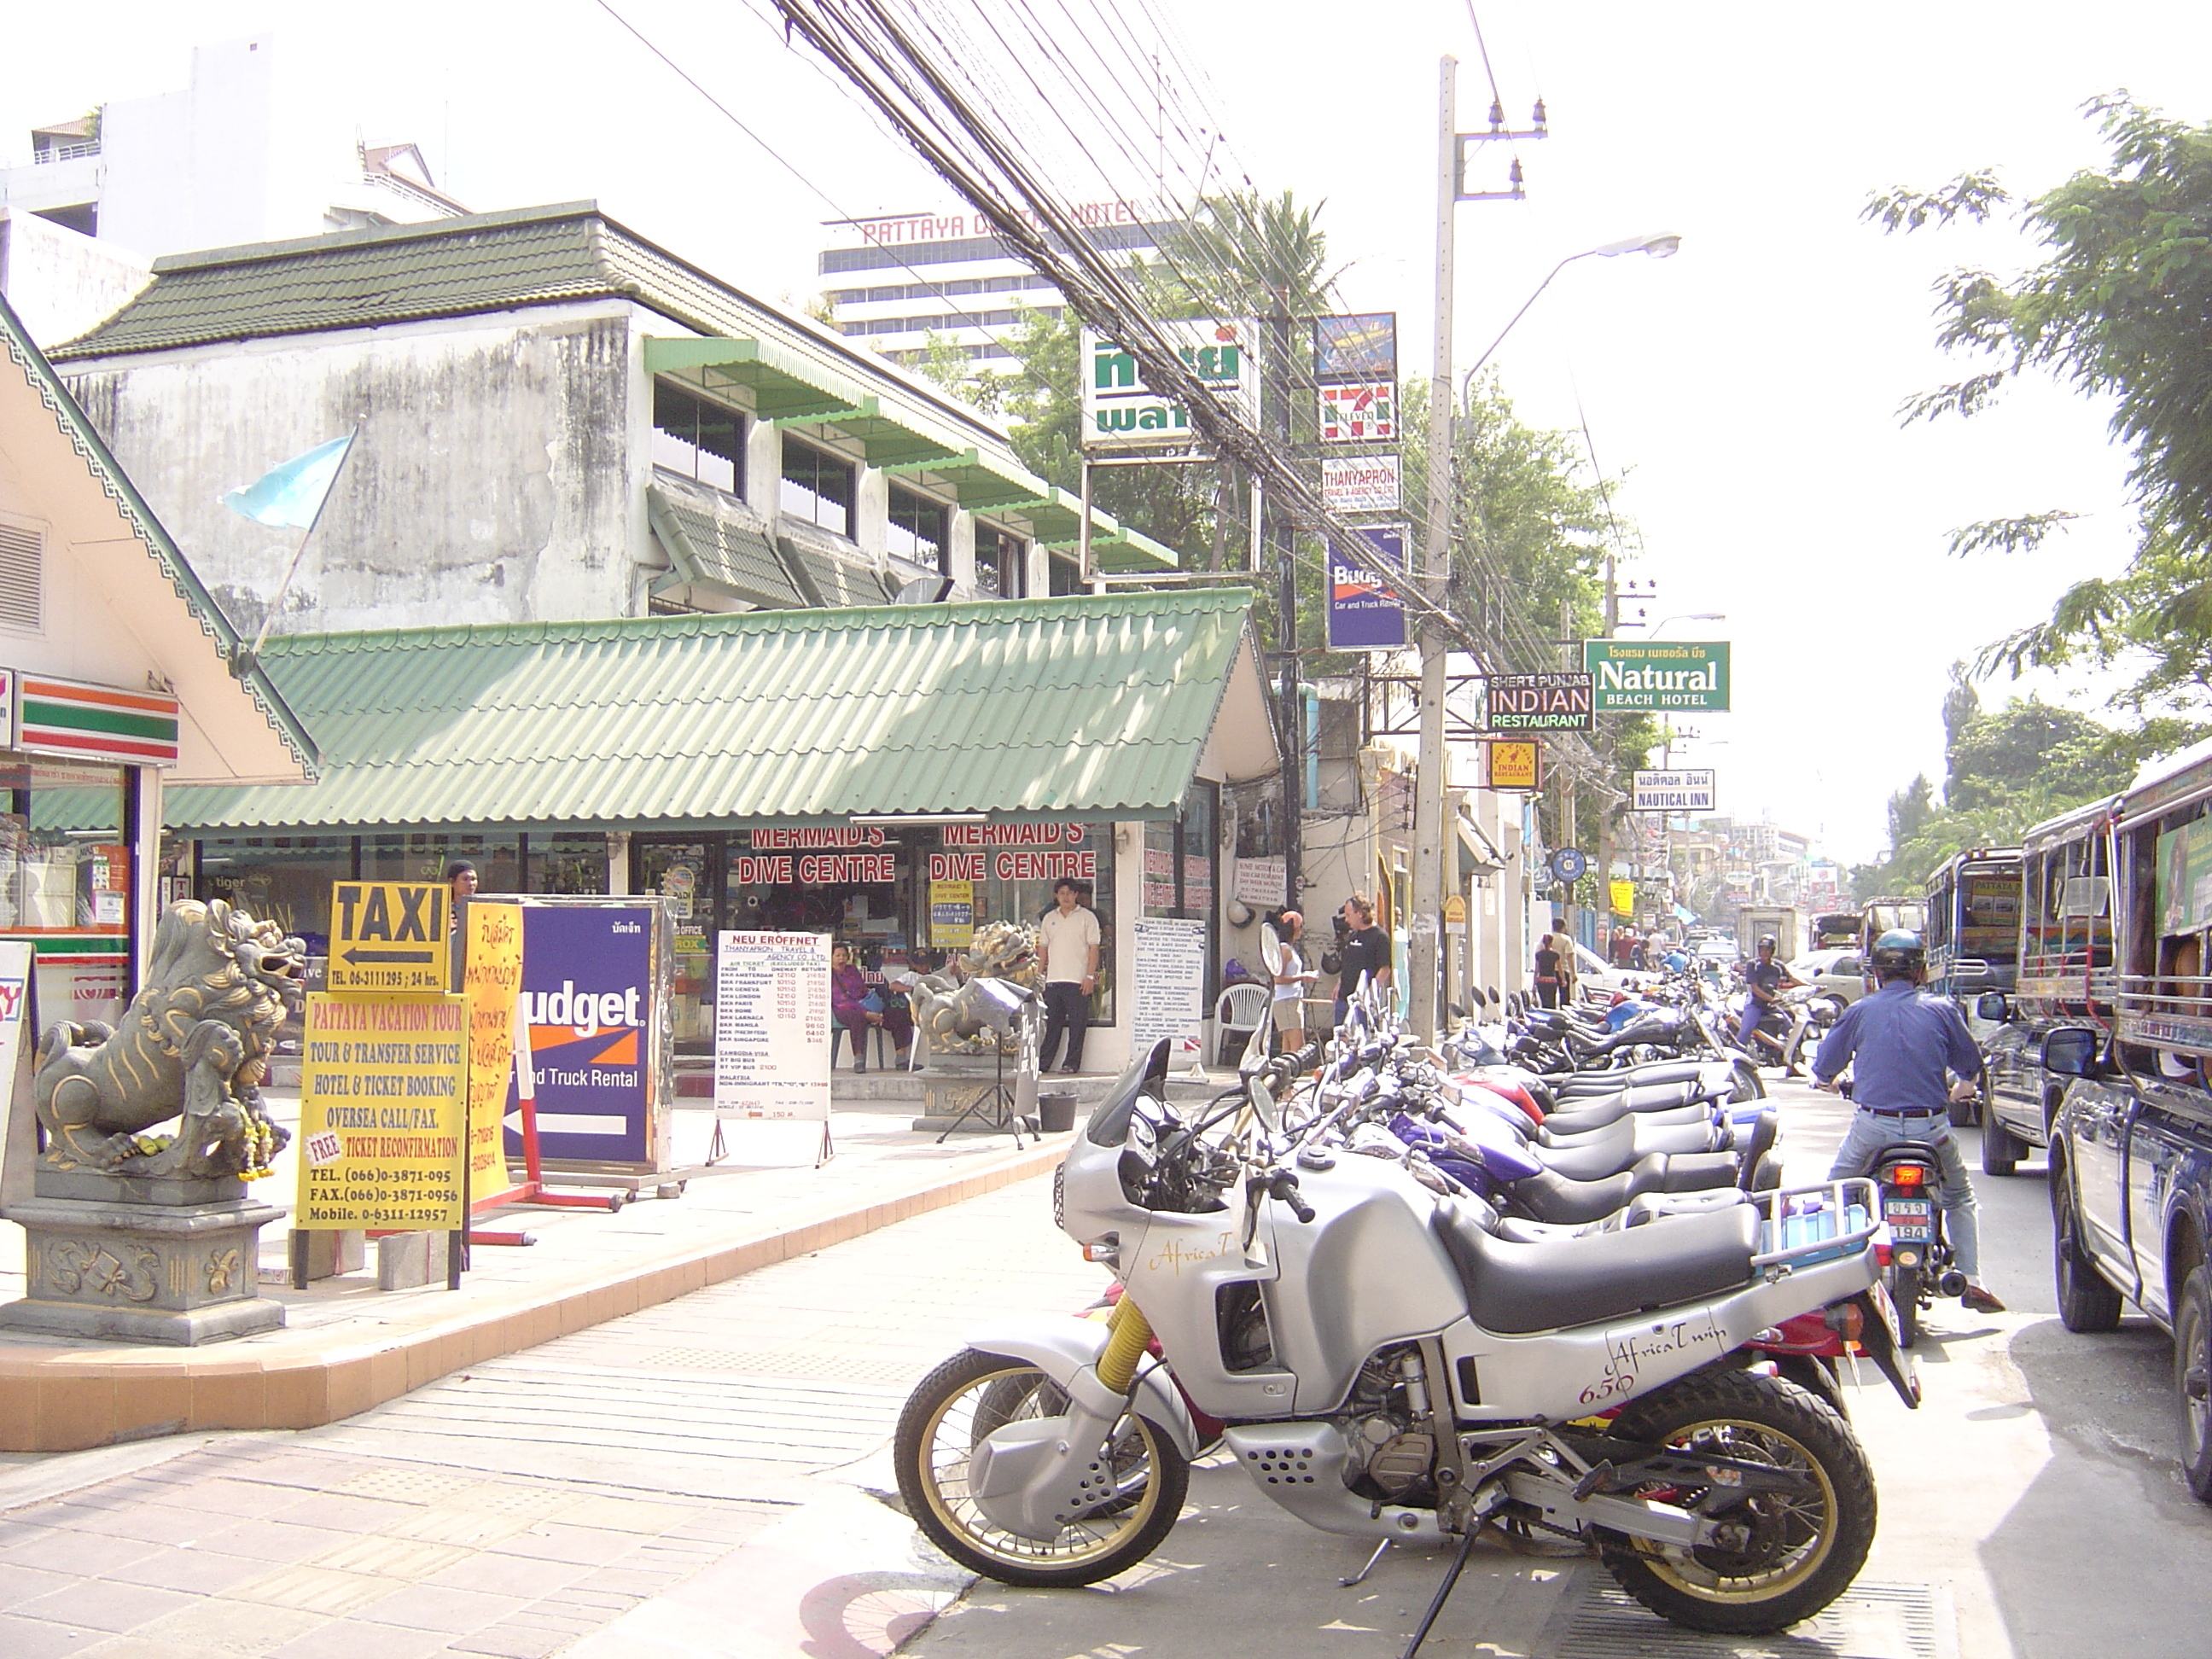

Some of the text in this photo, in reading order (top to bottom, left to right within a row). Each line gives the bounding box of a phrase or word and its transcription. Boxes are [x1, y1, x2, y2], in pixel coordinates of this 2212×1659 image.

[864, 216, 963, 244] PATTAYA
[1324, 469, 1394, 486] THANYAPRON
[1335, 602, 1346, 610] Car
[1347, 601, 1359, 609] and
[1361, 600, 1378, 608] Truck
[1540, 674, 1591, 687] PUNJAB
[1598, 661, 1717, 691] Natural
[1491, 688, 1590, 713] INDIAN
[1606, 694, 1708, 705] BEACH HOTEL
[1492, 714, 1587, 728] RESTAURANT
[1639, 792, 1708, 806] NAUTICAL INN
[752, 826, 885, 849] MERMAID'S
[943, 822, 1086, 846] MERMAID'S
[739, 854, 896, 884] DIVE CENTRE
[930, 851, 1097, 882] DIVE CENTRE
[216, 876, 245, 889] tiger
[1976, 882, 2012, 890] PATTAYA
[337, 886, 443, 942] TAXI
[681, 926, 702, 935] OFFICE
[733, 935, 756, 943] NEU
[302, 967, 322, 979] ive
[332, 971, 346, 985] TEL.
[349, 970, 402, 987] 06-3111295
[411, 972, 422, 986] 24
[425, 971, 439, 987] hrs.
[313, 1003, 367, 1030] PATTAYA
[371, 1004, 431, 1031] VACATION
[432, 1004, 462, 1032] TOUR
[523, 980, 640, 1037] udget
[310, 1042, 339, 1062] TOUR
[343, 1042, 351, 1063] &
[354, 1043, 411, 1064] TRANSFER
[414, 1044, 461, 1064] SERVICE
[314, 1074, 349, 1095] HOTEL
[352, 1075, 361, 1096] &
[364, 1075, 404, 1096] TICKET
[407, 1076, 456, 1097] BOOKING
[549, 1068, 588, 1086] Truck
[591, 1069, 638, 1087] Rental
[326, 1107, 439, 1132] OVERSEA CALL/FAX.
[310, 1134, 341, 1162] FREE
[346, 1137, 458, 1158] TICKET RECONFIRMATION
[311, 1167, 451, 1183] TEL. (066)0-3871-095
[310, 1208, 448, 1222] Mobile. 0-6311-12957
[1896, 1227, 1923, 1238] 194
[1149, 1238, 1216, 1276] Africa
[1604, 1322, 1726, 1376] Africa Twin
[1579, 1375, 1634, 1405] 650
